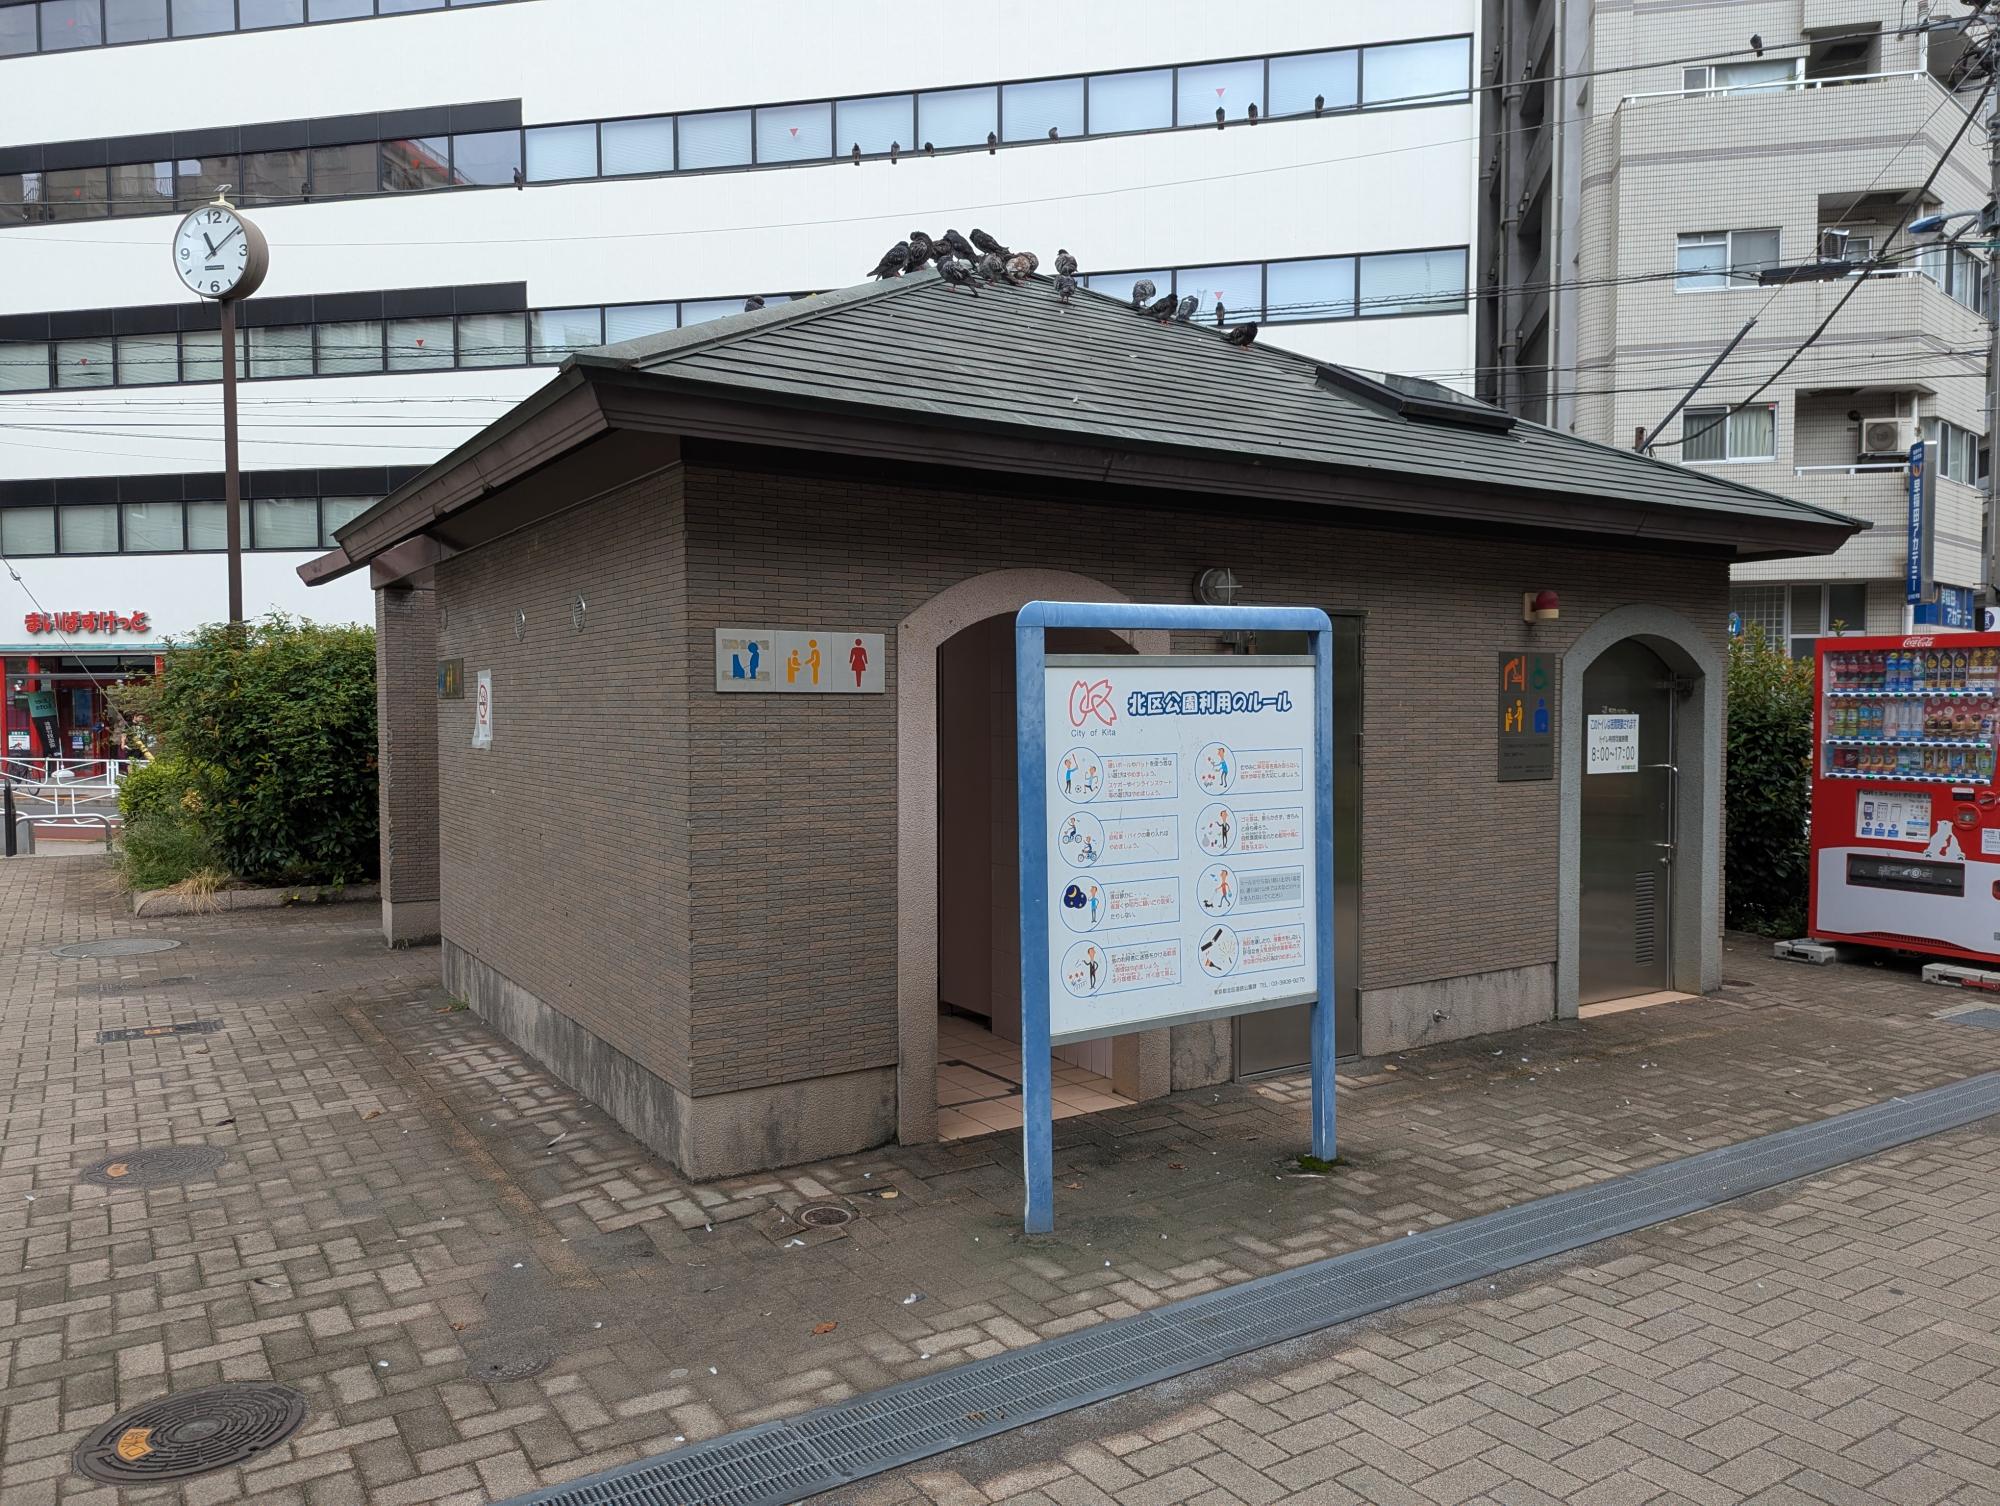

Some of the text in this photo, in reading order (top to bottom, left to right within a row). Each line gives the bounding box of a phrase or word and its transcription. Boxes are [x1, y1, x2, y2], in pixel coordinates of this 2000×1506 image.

[206, 211, 222, 224] 12
[180, 248, 190, 260] 9
[239, 244, 247, 256] 3
[210, 281, 220, 293] 6
[25, 611, 149, 633] まいばすけっと
[1127, 690, 1292, 716] 北区公園利用のルール
[1071, 728, 1116, 738] City of Kita
